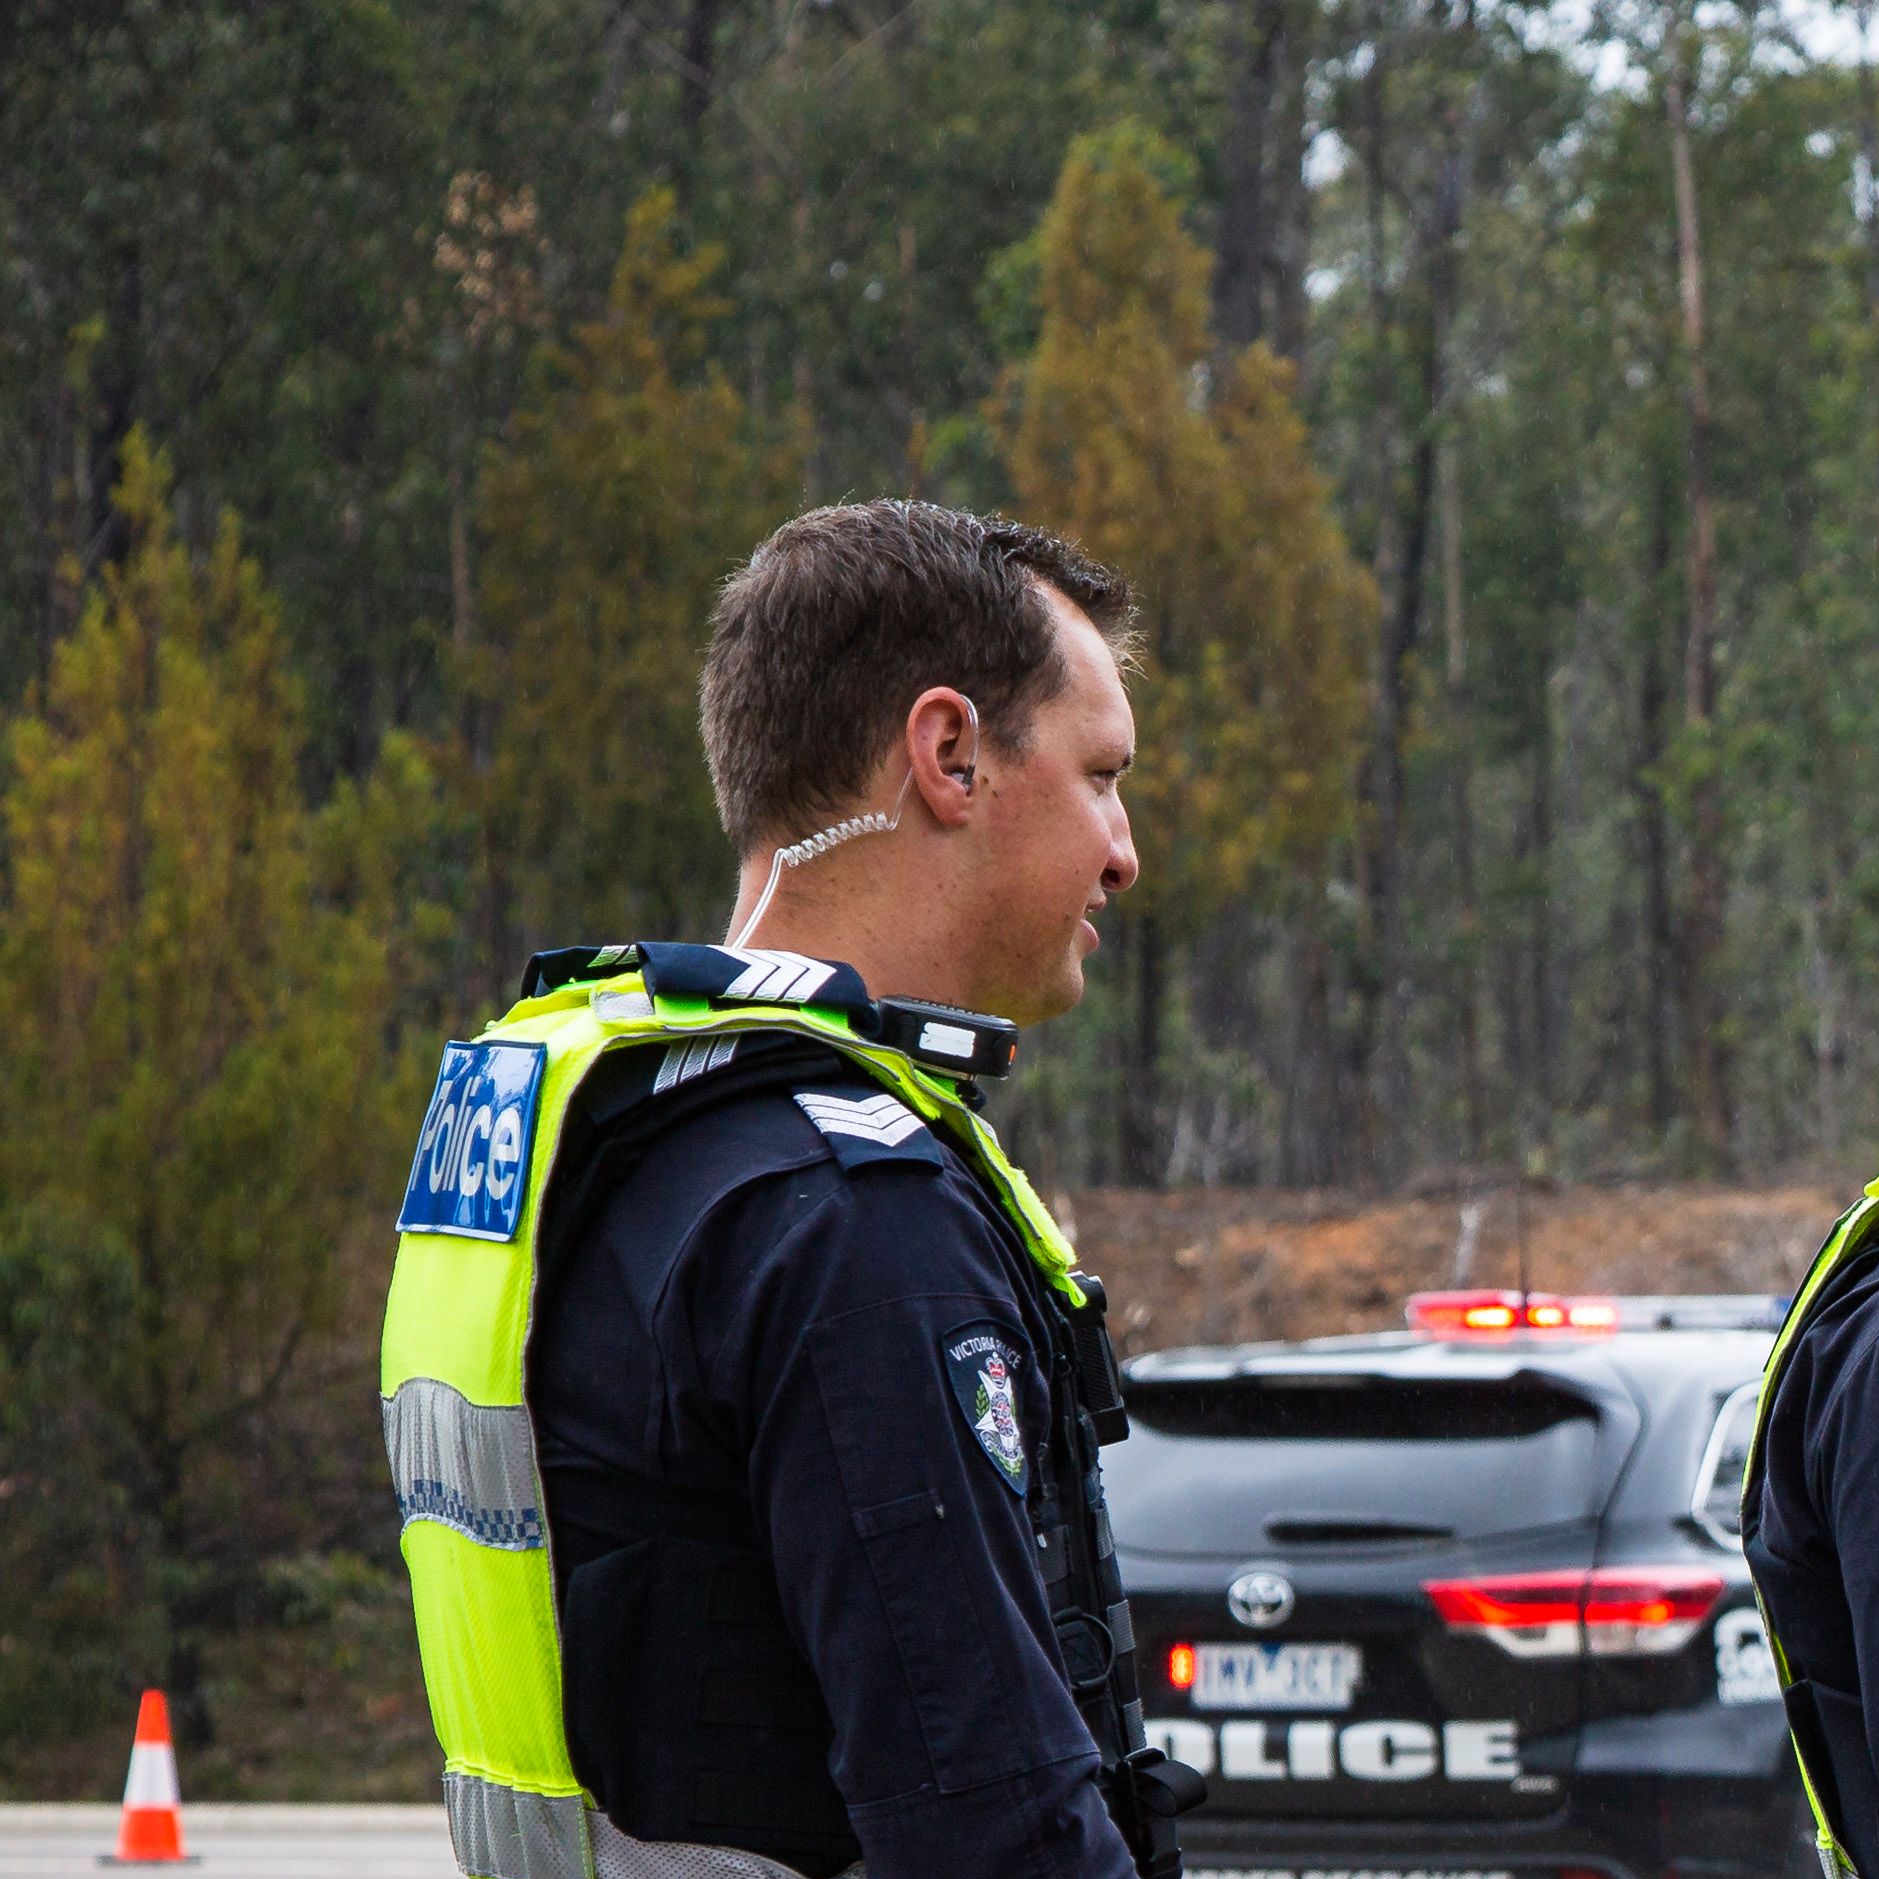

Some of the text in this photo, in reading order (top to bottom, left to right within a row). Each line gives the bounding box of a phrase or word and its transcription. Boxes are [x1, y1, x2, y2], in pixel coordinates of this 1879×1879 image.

[410, 1075, 522, 1200] Police
[948, 1336, 996, 1362] VICTORIA
[1145, 1718, 1519, 1781] OLICE
